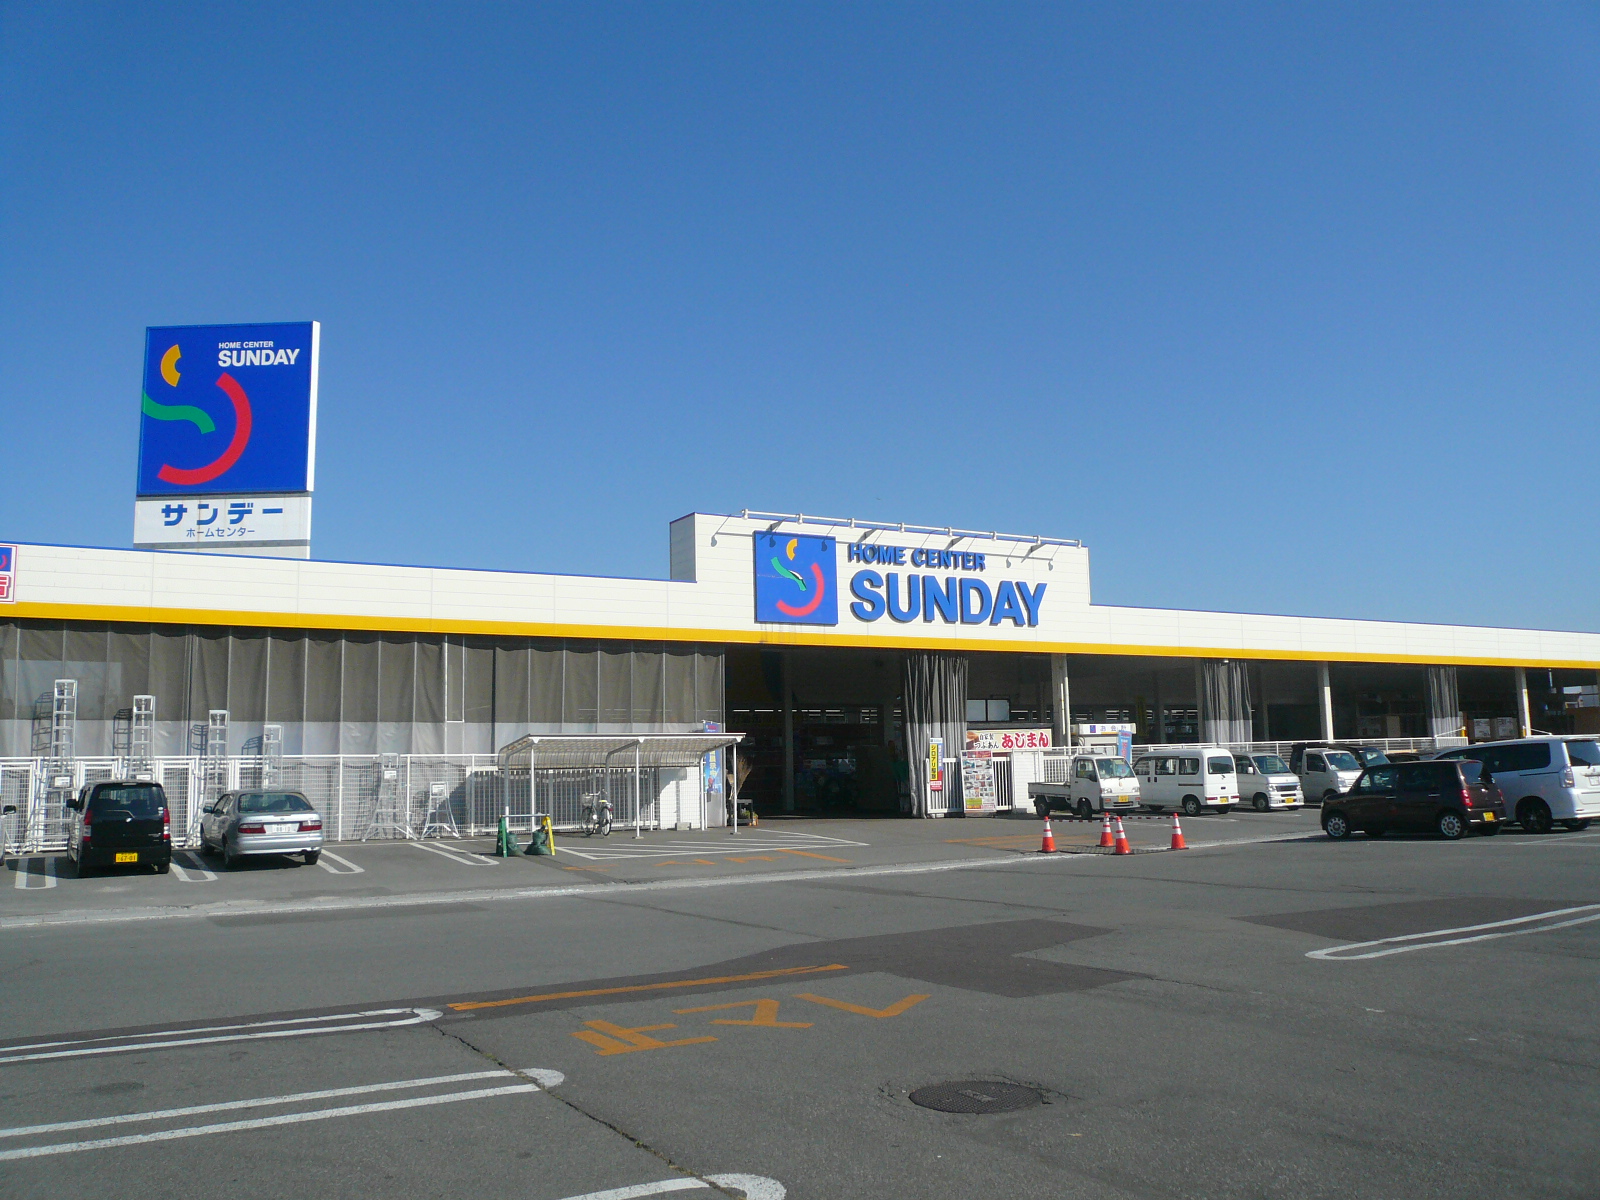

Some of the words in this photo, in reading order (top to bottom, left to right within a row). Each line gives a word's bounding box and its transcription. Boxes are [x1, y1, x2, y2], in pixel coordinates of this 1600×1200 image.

[218, 341, 241, 349] HOME
[243, 340, 274, 348] CENTER
[218, 348, 300, 367] SUNDAY
[161, 502, 283, 526] サンデー
[186, 527, 255, 538] ホームセンター
[848, 543, 907, 566] HOME
[911, 548, 986, 571] CENTER
[849, 569, 1048, 627] SUNDAY
[1001, 732, 1049, 749] あじまん
